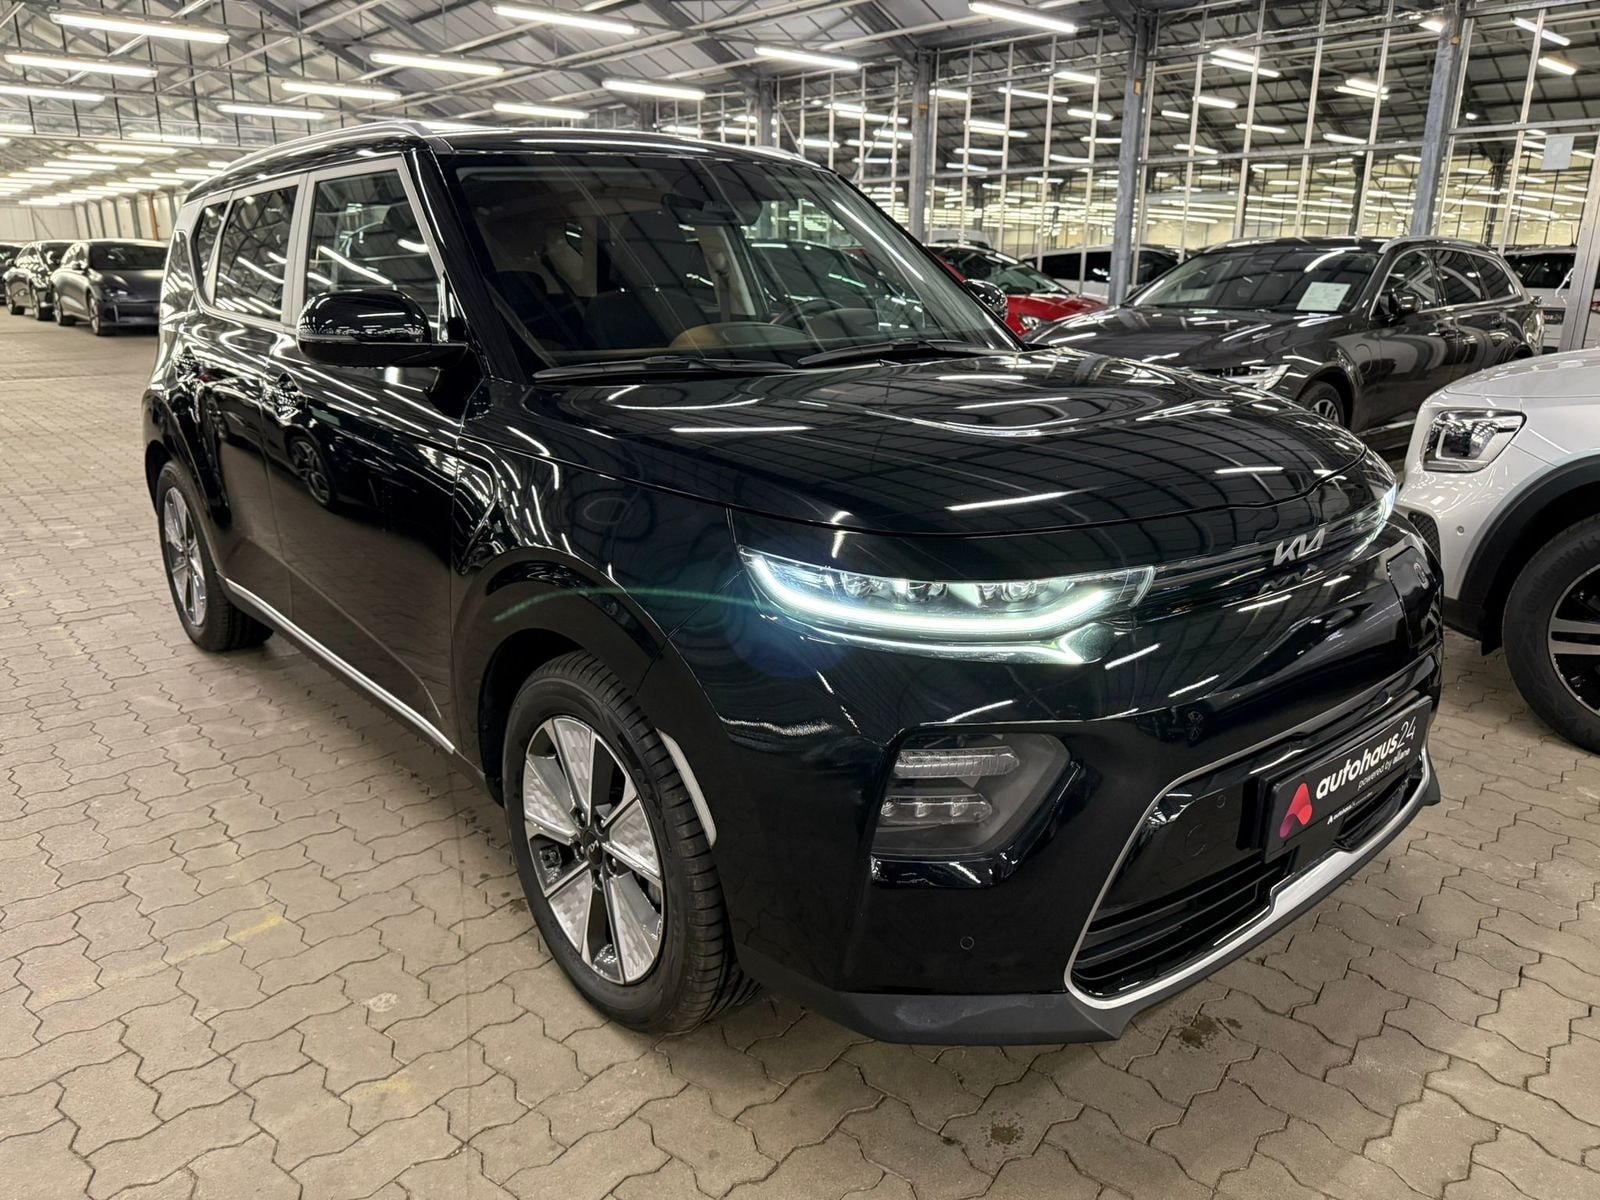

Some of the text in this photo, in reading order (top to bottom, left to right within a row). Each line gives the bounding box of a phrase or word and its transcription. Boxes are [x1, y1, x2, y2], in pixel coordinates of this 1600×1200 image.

[1273, 528, 1325, 566] KIA
[1315, 716, 1417, 800] autohaus24
[1357, 763, 1384, 791] powered
